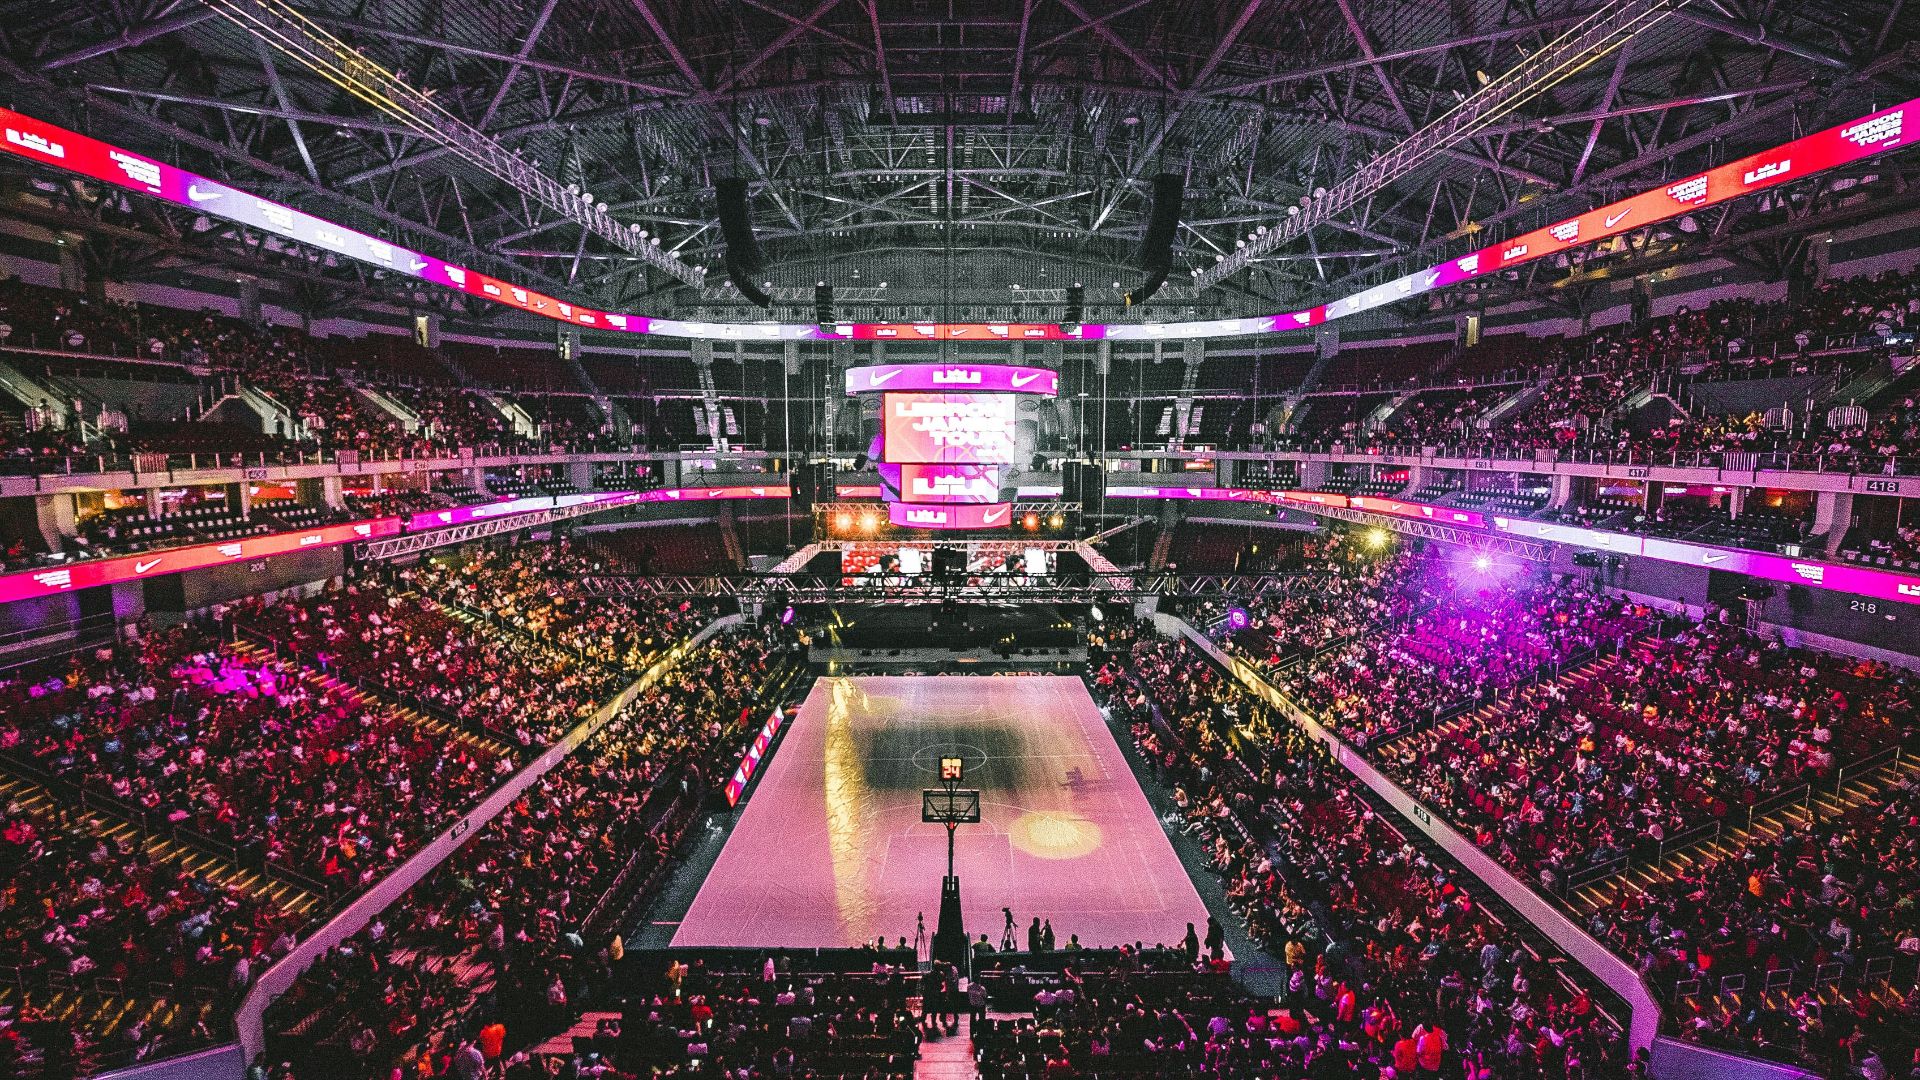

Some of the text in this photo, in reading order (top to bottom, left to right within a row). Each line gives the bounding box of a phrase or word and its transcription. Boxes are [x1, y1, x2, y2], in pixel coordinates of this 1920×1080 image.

[1841, 110, 1903, 138] LEBRON
[1849, 119, 1903, 142] JAMES
[1858, 127, 1902, 146] TOUR
[1678, 189, 1706, 202] TOUR
[895, 402, 1005, 417] LRON
[912, 417, 1005, 431] JAM
[1630, 469, 1645, 477] 417
[1869, 481, 1896, 492] 418
[1850, 600, 1876, 614] 218
[943, 766, 960, 779] 24
